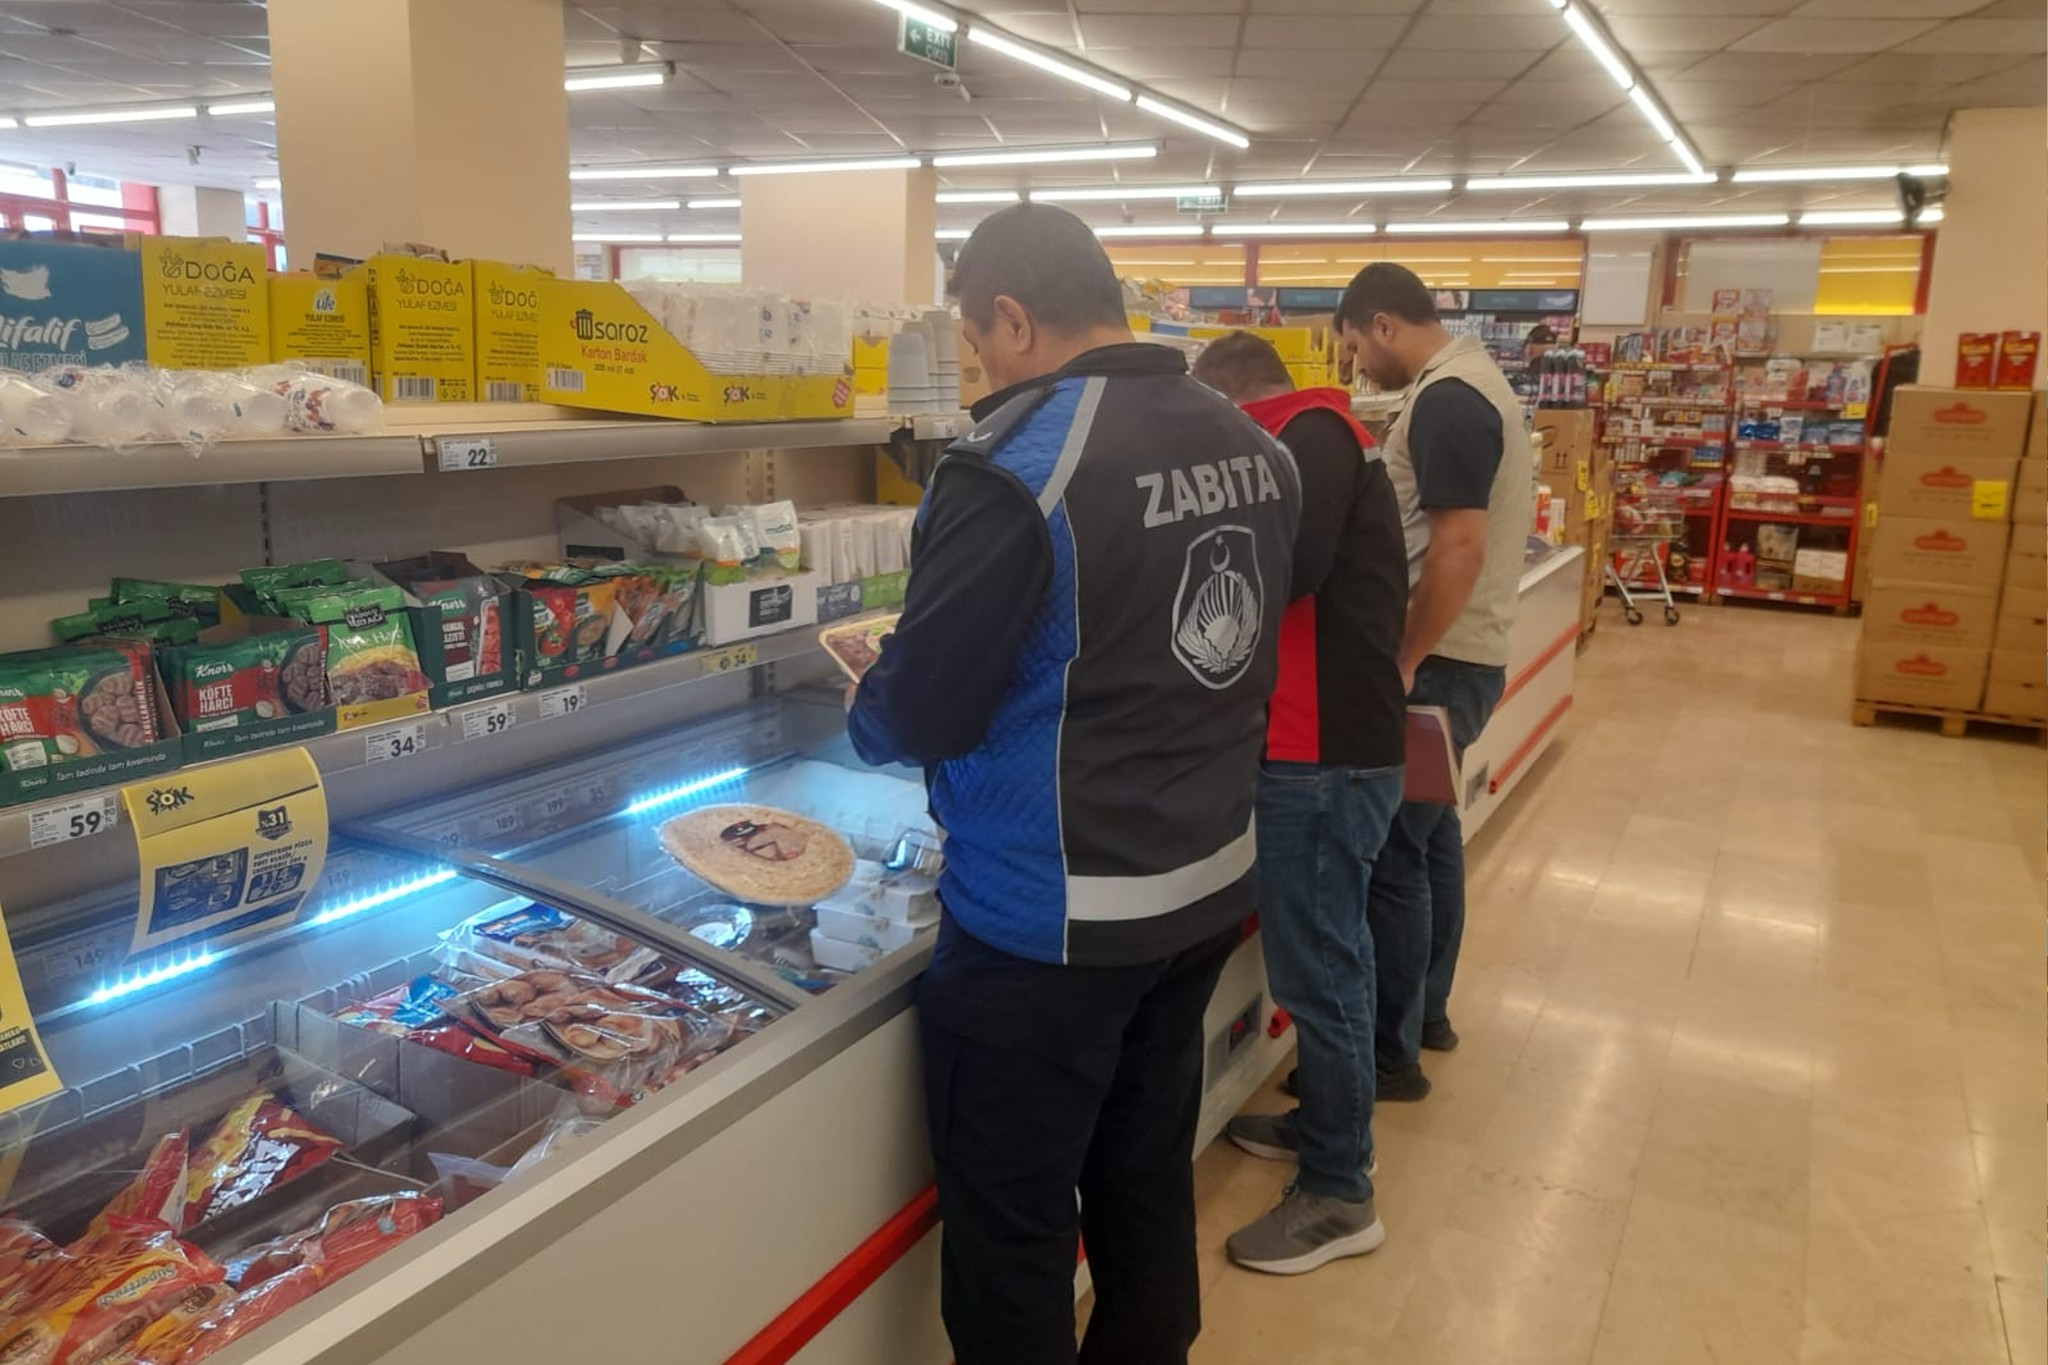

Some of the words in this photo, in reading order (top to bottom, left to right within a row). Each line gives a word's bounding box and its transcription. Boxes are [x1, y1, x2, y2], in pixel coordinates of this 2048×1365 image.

[926, 27, 952, 49] EXIT
[185, 260, 256, 285] DOĞA
[163, 283, 201, 297] YULAF
[417, 278, 465, 296] DOĞA
[396, 298, 427, 310] YULAF
[505, 290, 538, 308] DOĞ
[0, 313, 82, 352] ifalif
[594, 321, 649, 344] saroz
[613, 346, 648, 363] Bardak
[468, 448, 488, 467] 22
[1135, 454, 1281, 529] ZABITA
[195, 661, 235, 678] Knorr
[562, 694, 580, 713] 19
[487, 712, 507, 733] 59
[391, 736, 415, 758] 34
[146, 786, 195, 816] ŞOK
[69, 810, 101, 838] 59
